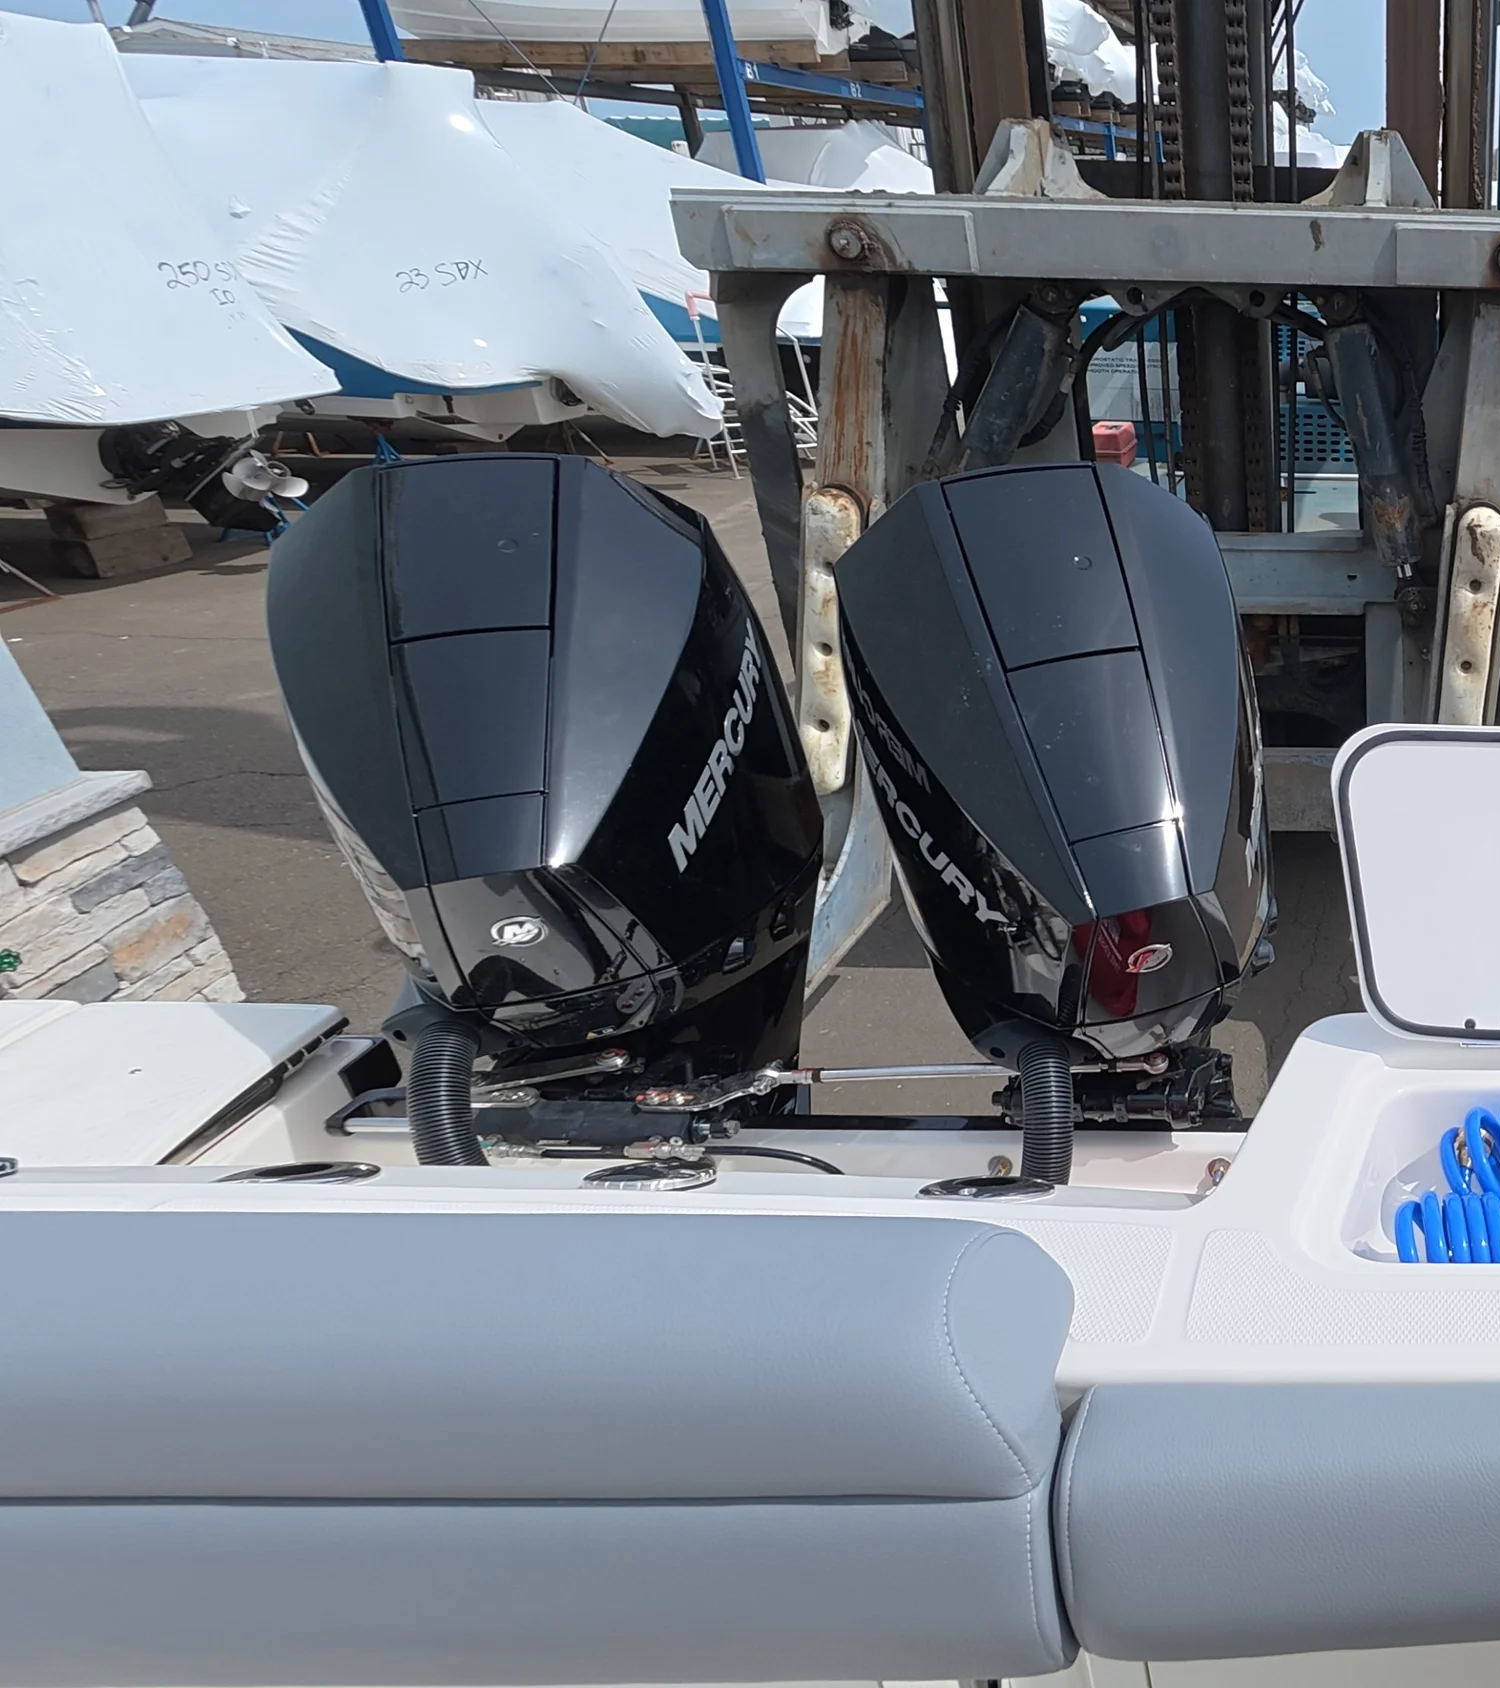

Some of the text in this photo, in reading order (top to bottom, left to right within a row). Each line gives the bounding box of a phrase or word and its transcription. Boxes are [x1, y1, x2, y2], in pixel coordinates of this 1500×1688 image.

[744, 62, 760, 80] B1
[850, 82, 863, 98] B2
[157, 260, 210, 289] 250
[395, 267, 430, 293] 23
[667, 617, 763, 874] MERCURY
